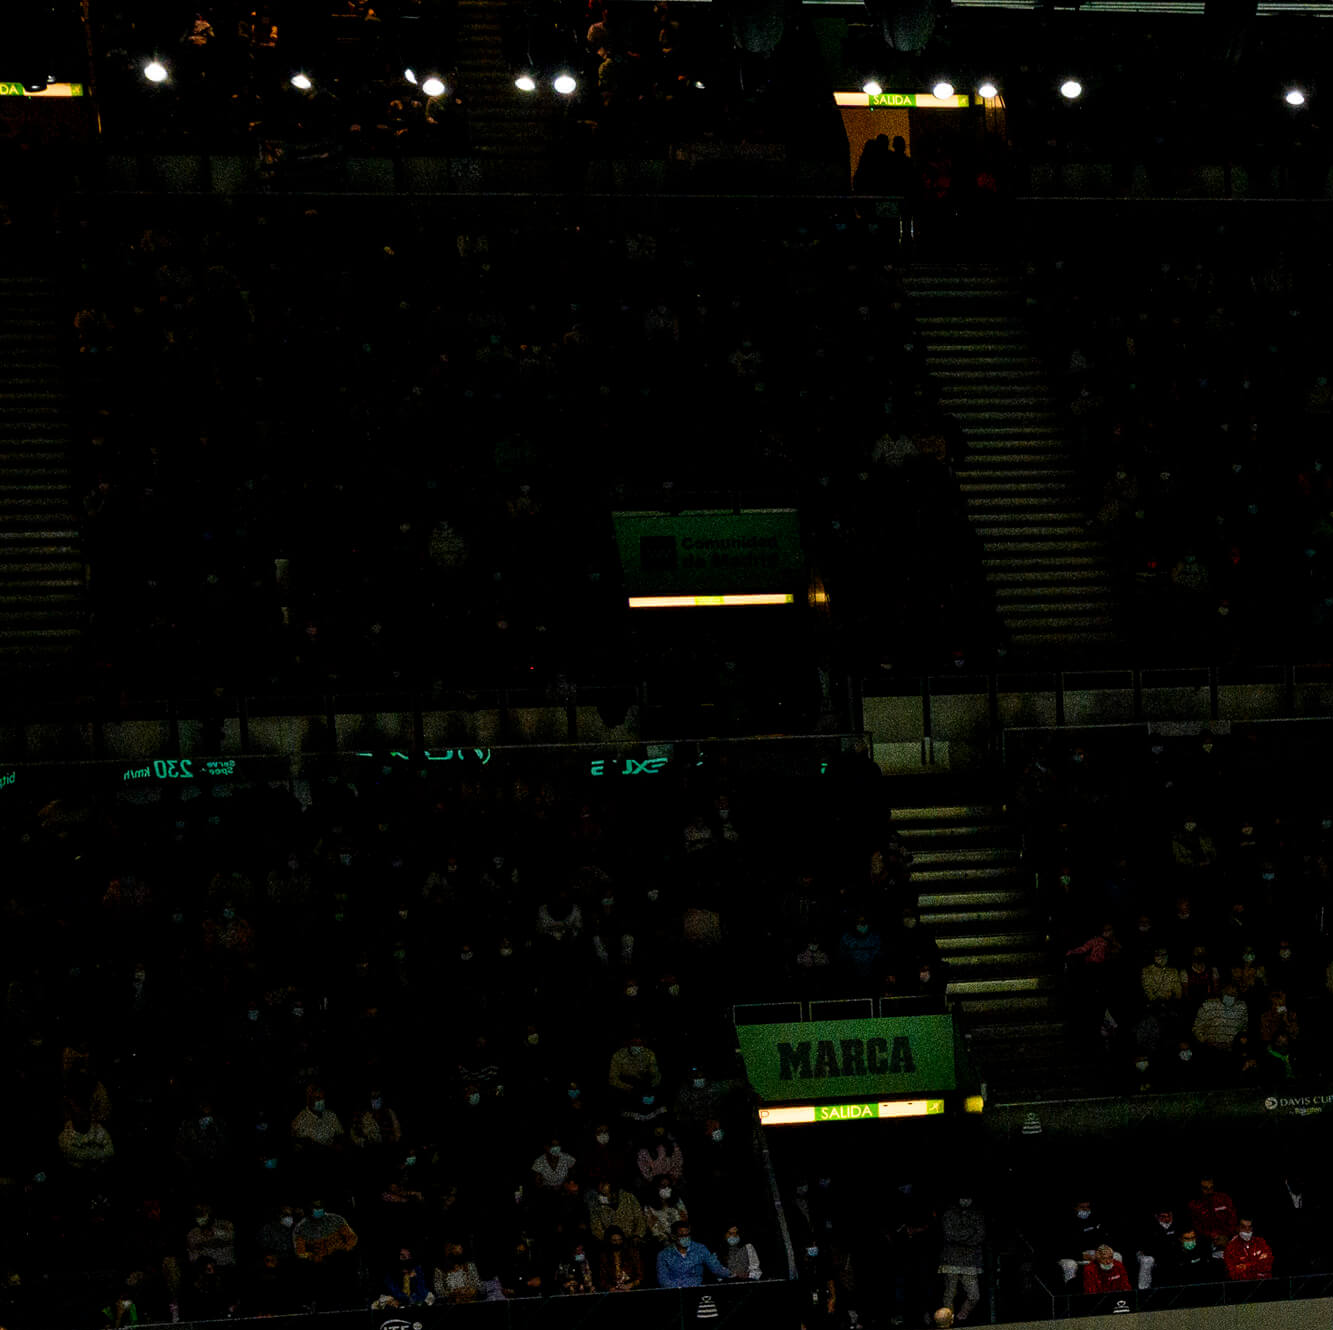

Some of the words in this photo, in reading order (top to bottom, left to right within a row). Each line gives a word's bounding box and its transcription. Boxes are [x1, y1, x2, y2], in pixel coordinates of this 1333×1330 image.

[873, 95, 912, 105] SALIDA
[777, 1036, 916, 1080] MARCA
[1280, 1098, 1311, 1108] DAVIS
[821, 1104, 872, 1120] SALIDA
